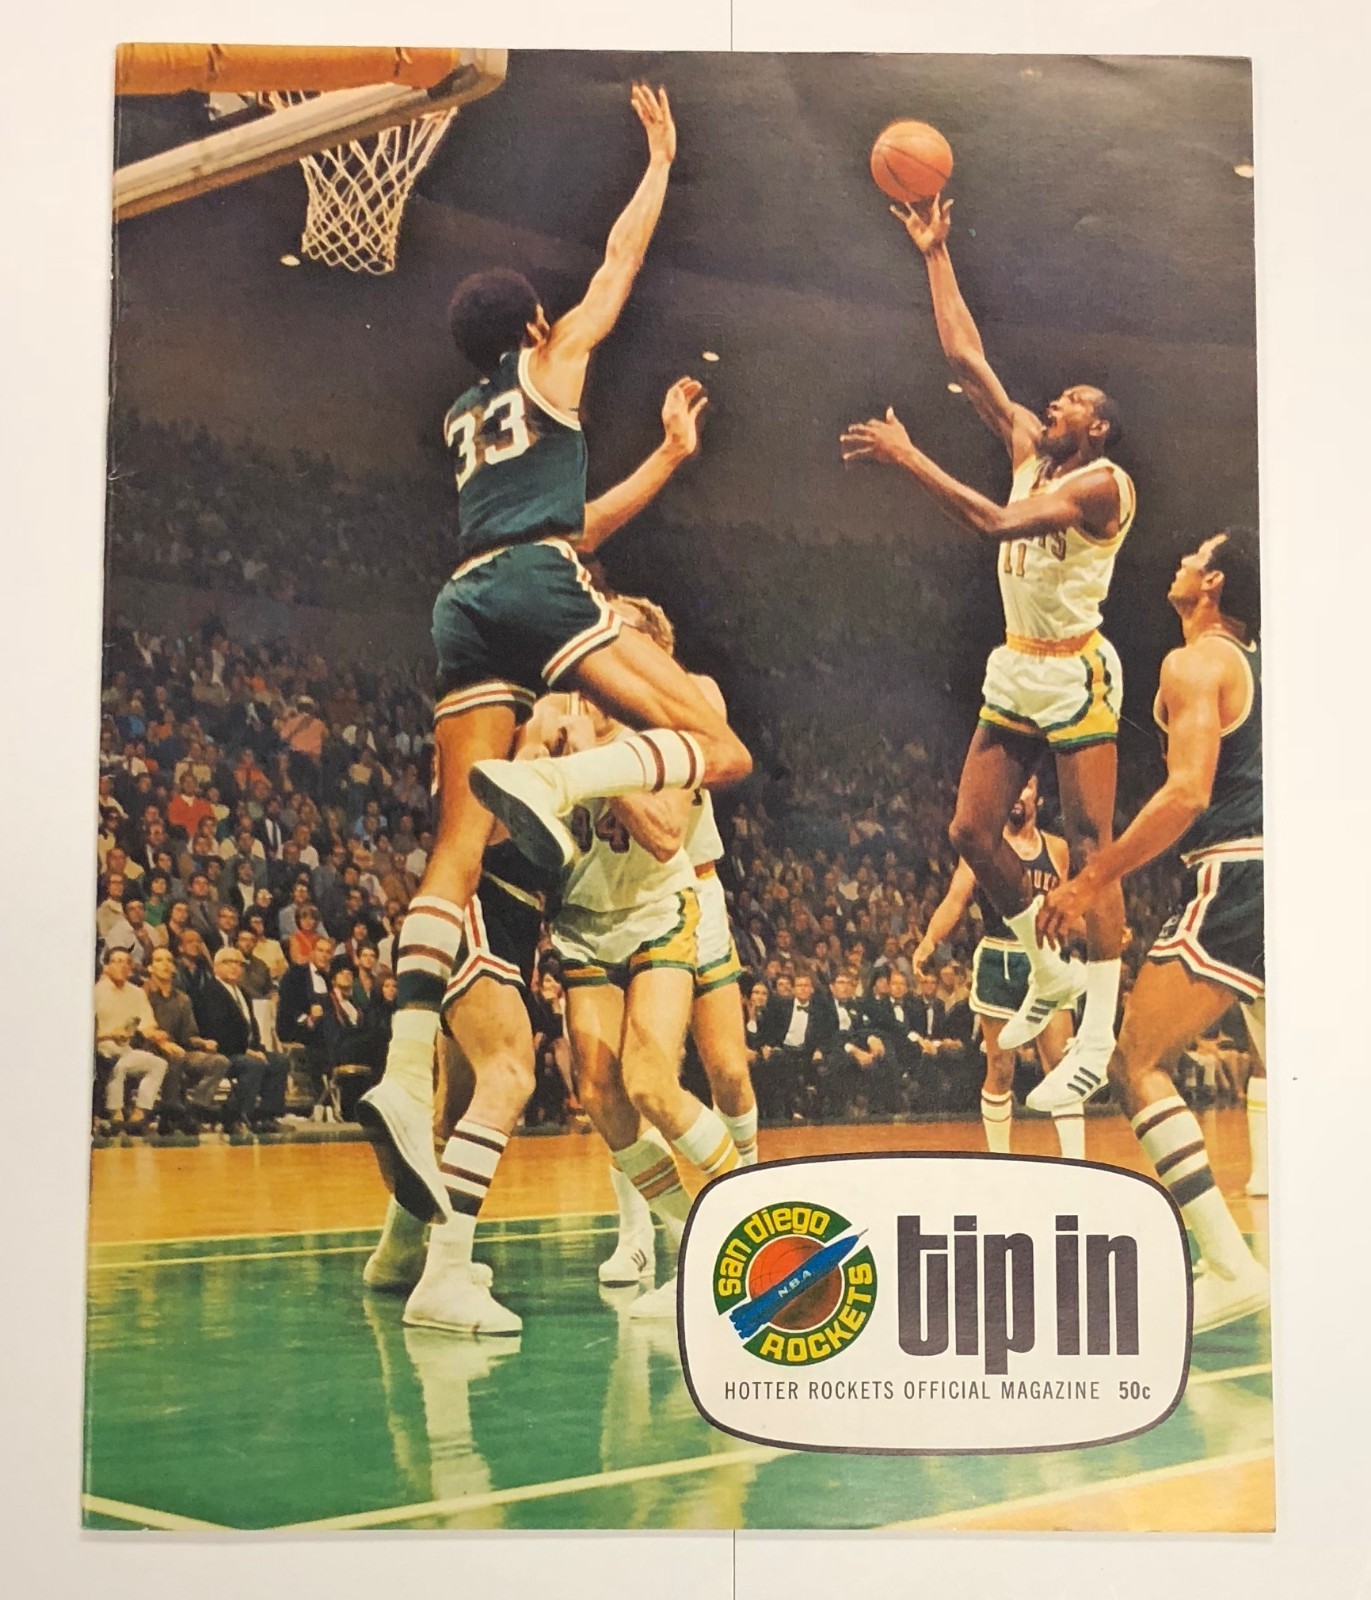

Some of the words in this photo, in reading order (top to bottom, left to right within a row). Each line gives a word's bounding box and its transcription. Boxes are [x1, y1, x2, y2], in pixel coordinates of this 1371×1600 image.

[447, 389, 530, 492] 33
[718, 1238, 752, 1297] san
[743, 1206, 831, 1243] diego
[897, 1215, 1036, 1375] tip
[1055, 1215, 1140, 1356] in
[760, 1262, 873, 1362] ROCKETS
[725, 1381, 798, 1400] HOTTER
[809, 1381, 894, 1400] ROCKETS
[904, 1381, 991, 1400] OFFICIAL
[1001, 1381, 1100, 1400] MAGAZINE
